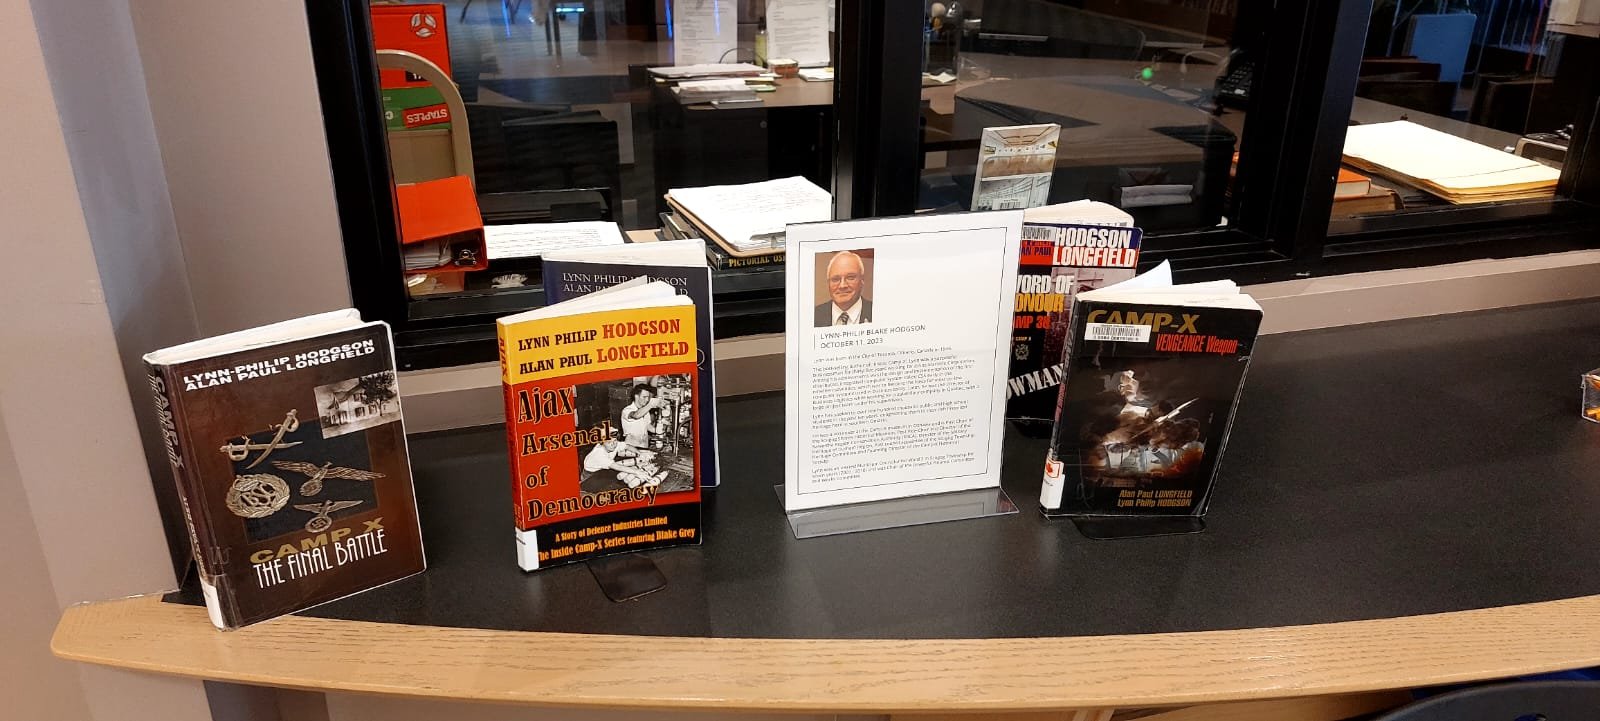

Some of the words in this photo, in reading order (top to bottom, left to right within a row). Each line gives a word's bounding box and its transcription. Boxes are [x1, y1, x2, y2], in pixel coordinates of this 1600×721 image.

[406, 109, 448, 123] STAPLES
[1055, 227, 1132, 248] HODGSON
[728, 256, 770, 267] PICTORIAL
[1053, 246, 1136, 268] LONGFIELD
[563, 273, 590, 282] LYNN
[563, 283, 592, 292] ALAN
[1016, 275, 1051, 294] ORD
[1055, 275, 1075, 294] OF
[820, 330, 865, 340] LYNN-PHILIP
[866, 328, 888, 336] BLAKE
[890, 325, 926, 334] HODGSON
[1087, 310, 1200, 333] CAMP-X
[518, 336, 550, 352] LYNN
[555, 329, 597, 345] PHILIP
[602, 319, 681, 339] HODGSON
[820, 340, 854, 349] OCTOBER
[1156, 334, 1205, 353] VENGEANCE
[1206, 337, 1238, 356] Weapon
[183, 356, 290, 385] LYNN-PHILIP
[295, 339, 374, 362] HODGSON
[185, 373, 233, 392] ALAN
[237, 365, 283, 382] PAUL
[287, 346, 376, 370] LONGFIELD
[520, 359, 554, 375] ALAN
[560, 354, 592, 369] PAUL
[597, 342, 689, 363] LONGFIELD
[518, 387, 574, 424] Ajax
[522, 421, 612, 456] Arsenal
[525, 466, 550, 489] of
[527, 485, 658, 521] Democracy
[1118, 499, 1134, 508] Lynn
[1136, 499, 1156, 508] Philip
[1157, 499, 1192, 507] HODGSON
[1120, 490, 1136, 498] Alan
[1137, 490, 1154, 498] Paul
[1154, 490, 1192, 498] LONGFIELD
[249, 527, 354, 565] CAMP
[363, 517, 386, 531] X
[556, 534, 561, 543] A
[562, 530, 578, 542] Story
[578, 528, 586, 538] of
[586, 524, 612, 537] Defence
[612, 519, 644, 532] Industries
[644, 516, 668, 528] Limited
[551, 546, 574, 558] Inside
[575, 542, 602, 555] Camp-X
[604, 537, 626, 549] Series
[627, 534, 655, 546] featuring
[656, 530, 678, 542] Blake
[679, 528, 696, 539] Grey
[252, 558, 283, 590] THE
[287, 548, 333, 580] FINAL
[336, 530, 388, 566] BATTLE
